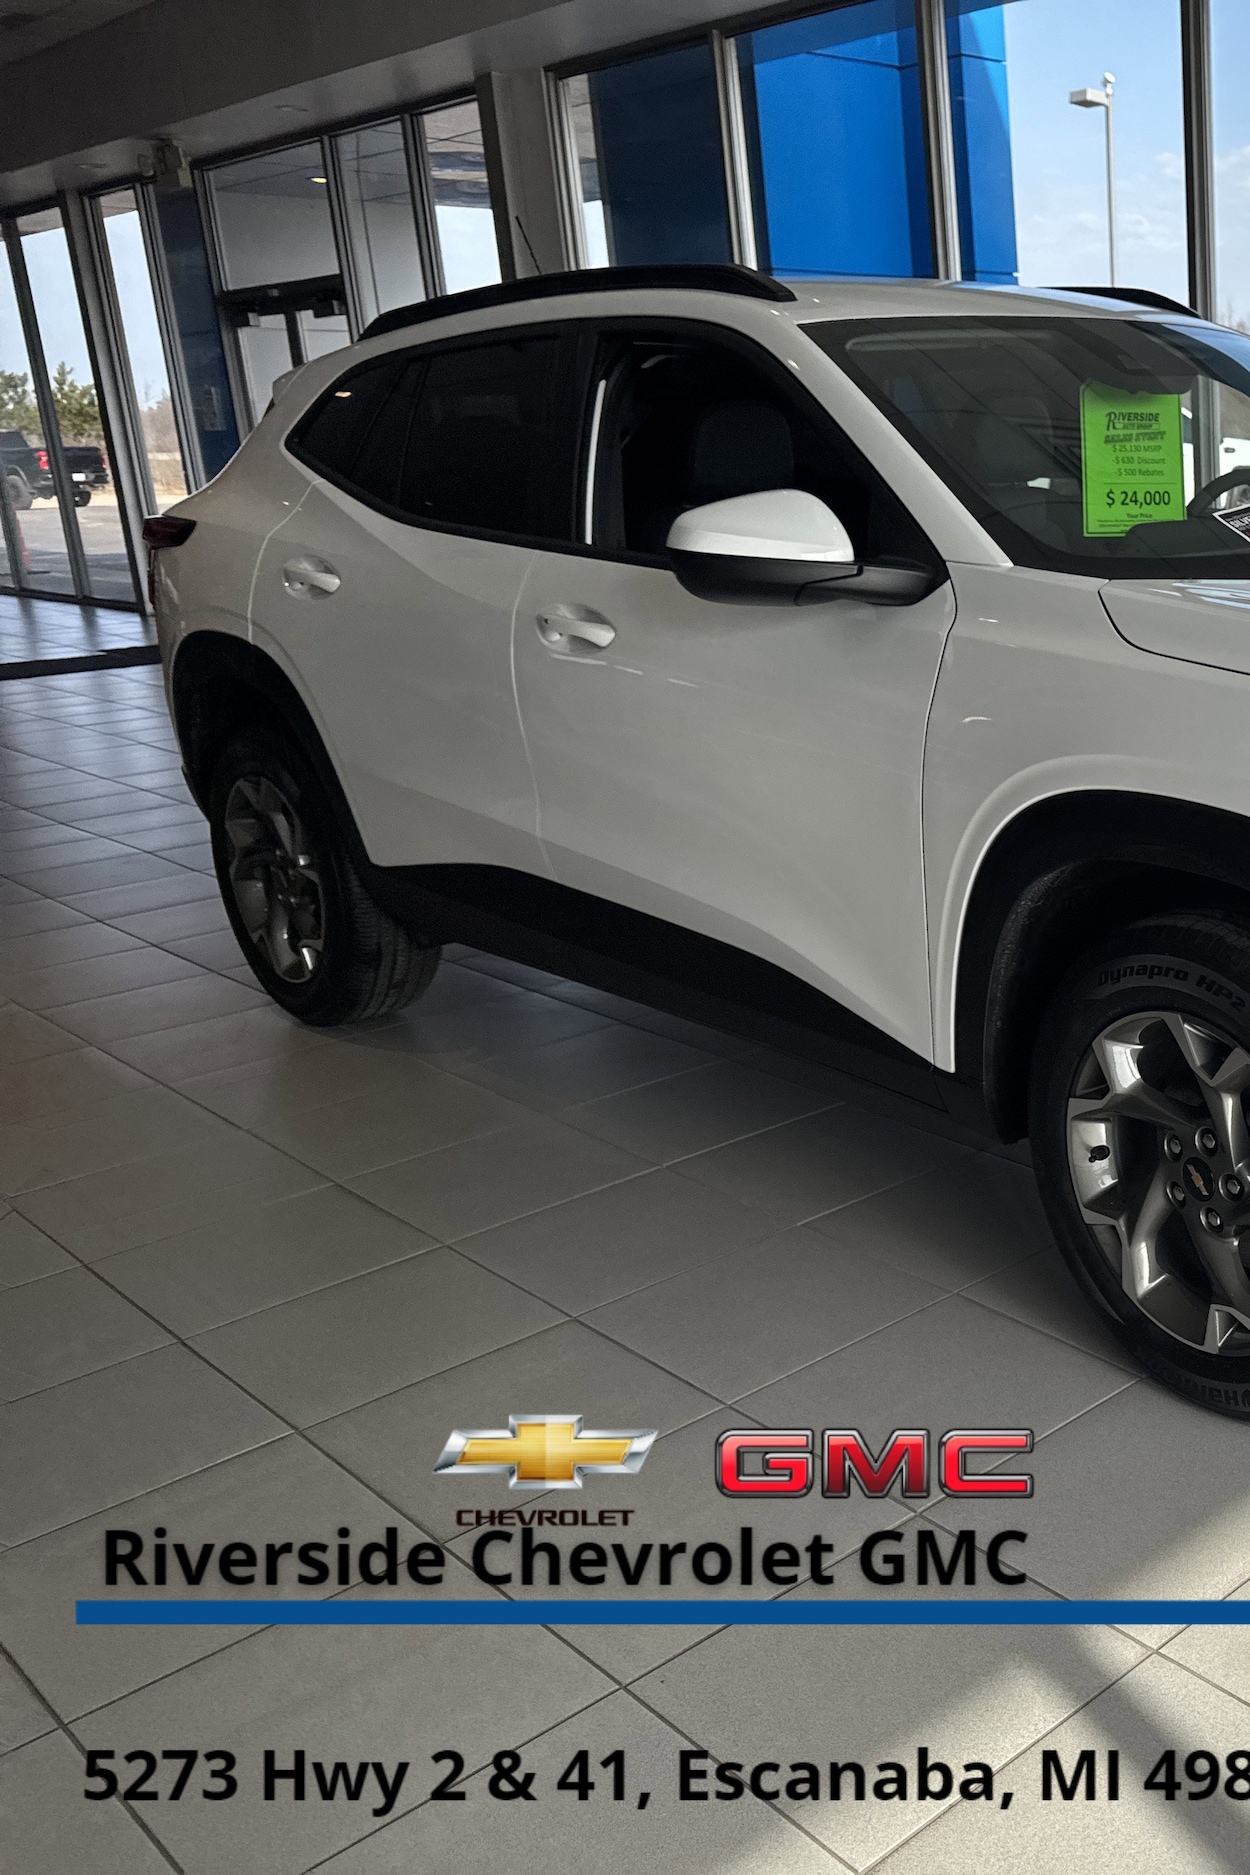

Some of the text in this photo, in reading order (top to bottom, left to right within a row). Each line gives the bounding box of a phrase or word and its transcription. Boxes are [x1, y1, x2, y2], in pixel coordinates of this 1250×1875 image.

[1105, 411, 1160, 431] RIVERSIDE
[1106, 488, 1171, 509] $ 24,000
[1195, 974, 1246, 1012] HP2
